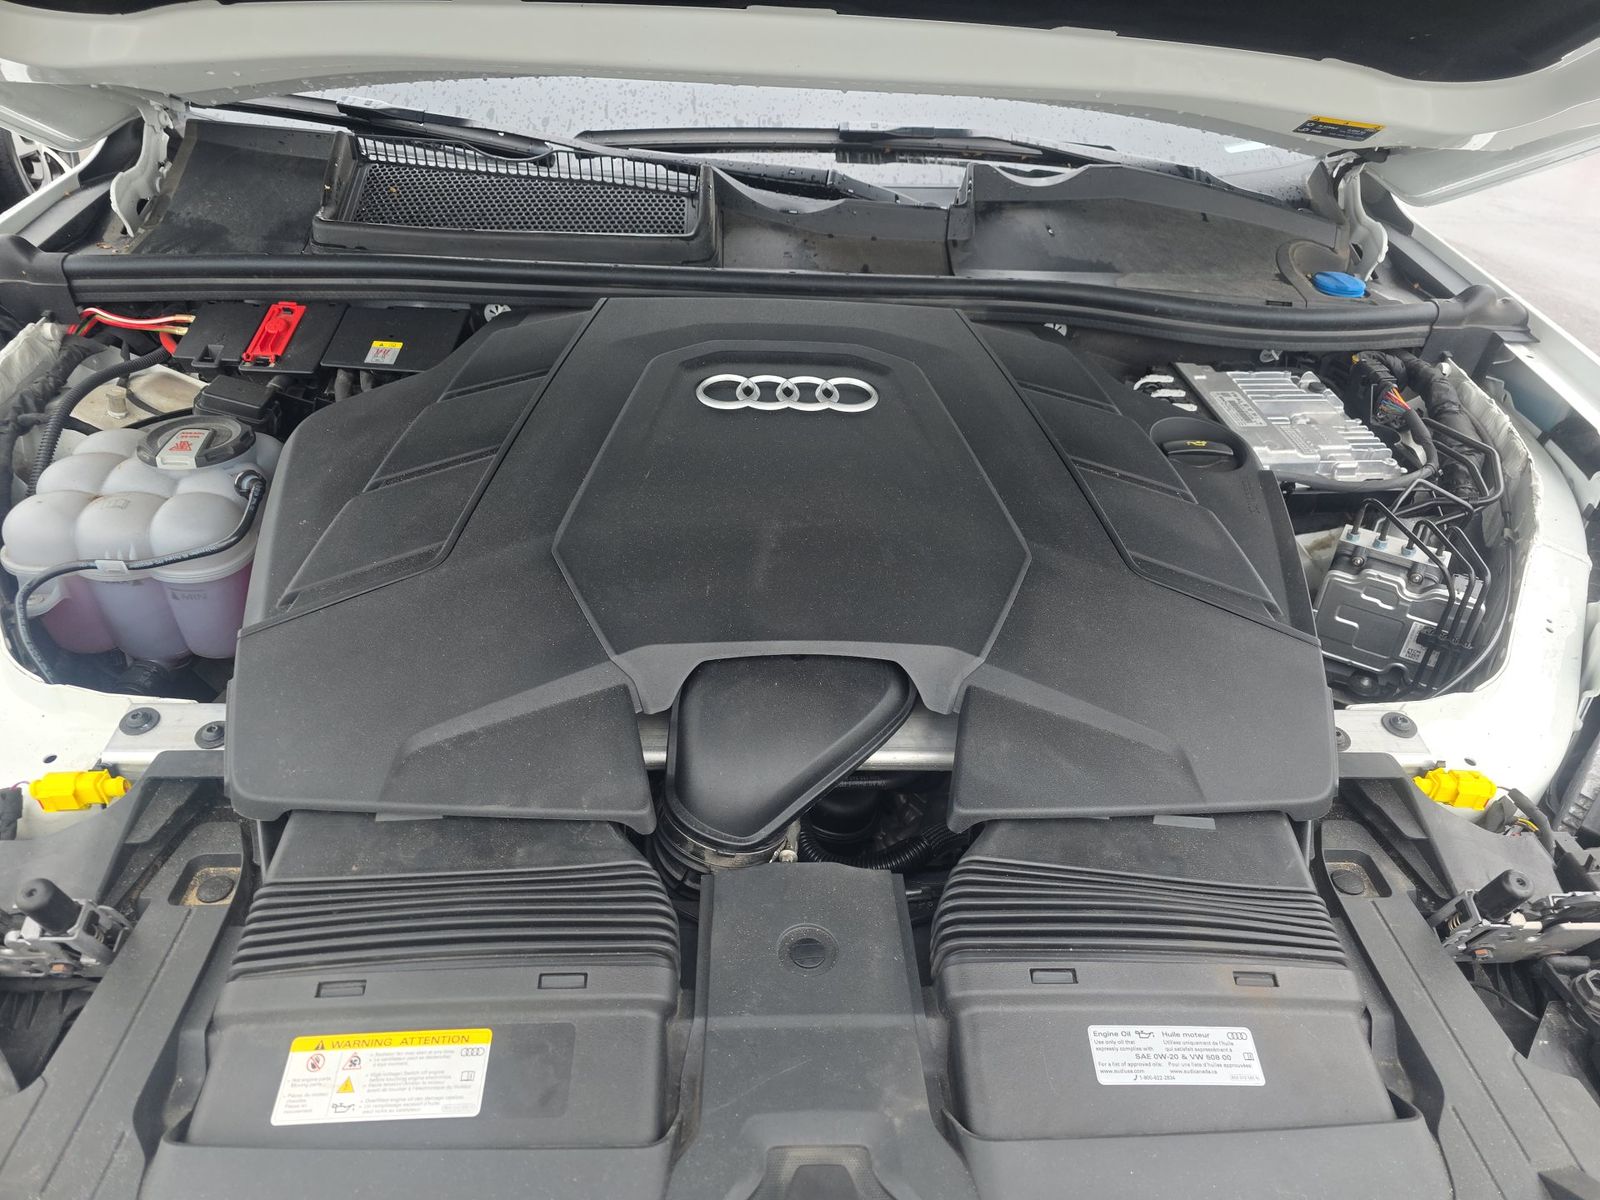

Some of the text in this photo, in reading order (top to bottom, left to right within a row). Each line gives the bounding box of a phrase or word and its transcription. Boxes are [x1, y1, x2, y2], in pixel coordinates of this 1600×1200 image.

[1093, 1031, 1119, 1039] Engine
[331, 1034, 471, 1049] WARNING ATTENTION
